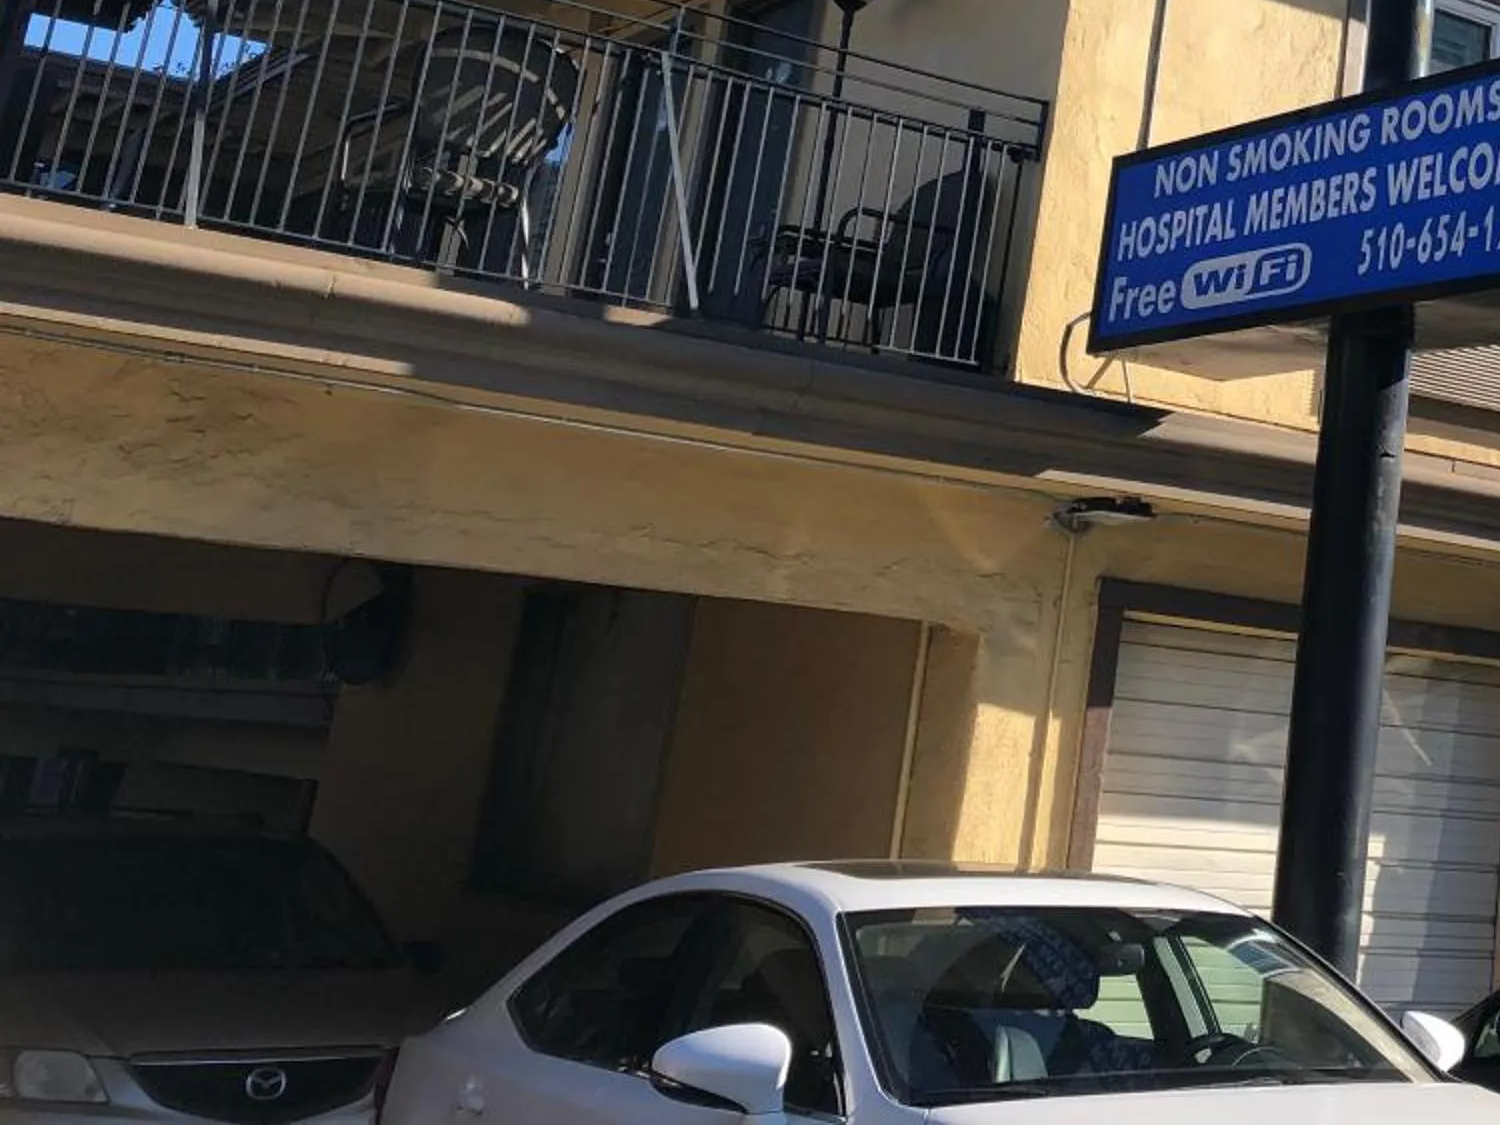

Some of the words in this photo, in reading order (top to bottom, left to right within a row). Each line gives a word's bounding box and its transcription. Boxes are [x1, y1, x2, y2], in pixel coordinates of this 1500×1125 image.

[1154, 150, 1219, 199] NON
[1225, 113, 1372, 183] SMOKING
[1117, 197, 1236, 263] HOSPITAL
[1243, 167, 1378, 237] MEMBERS
[1107, 276, 1177, 323] Free
